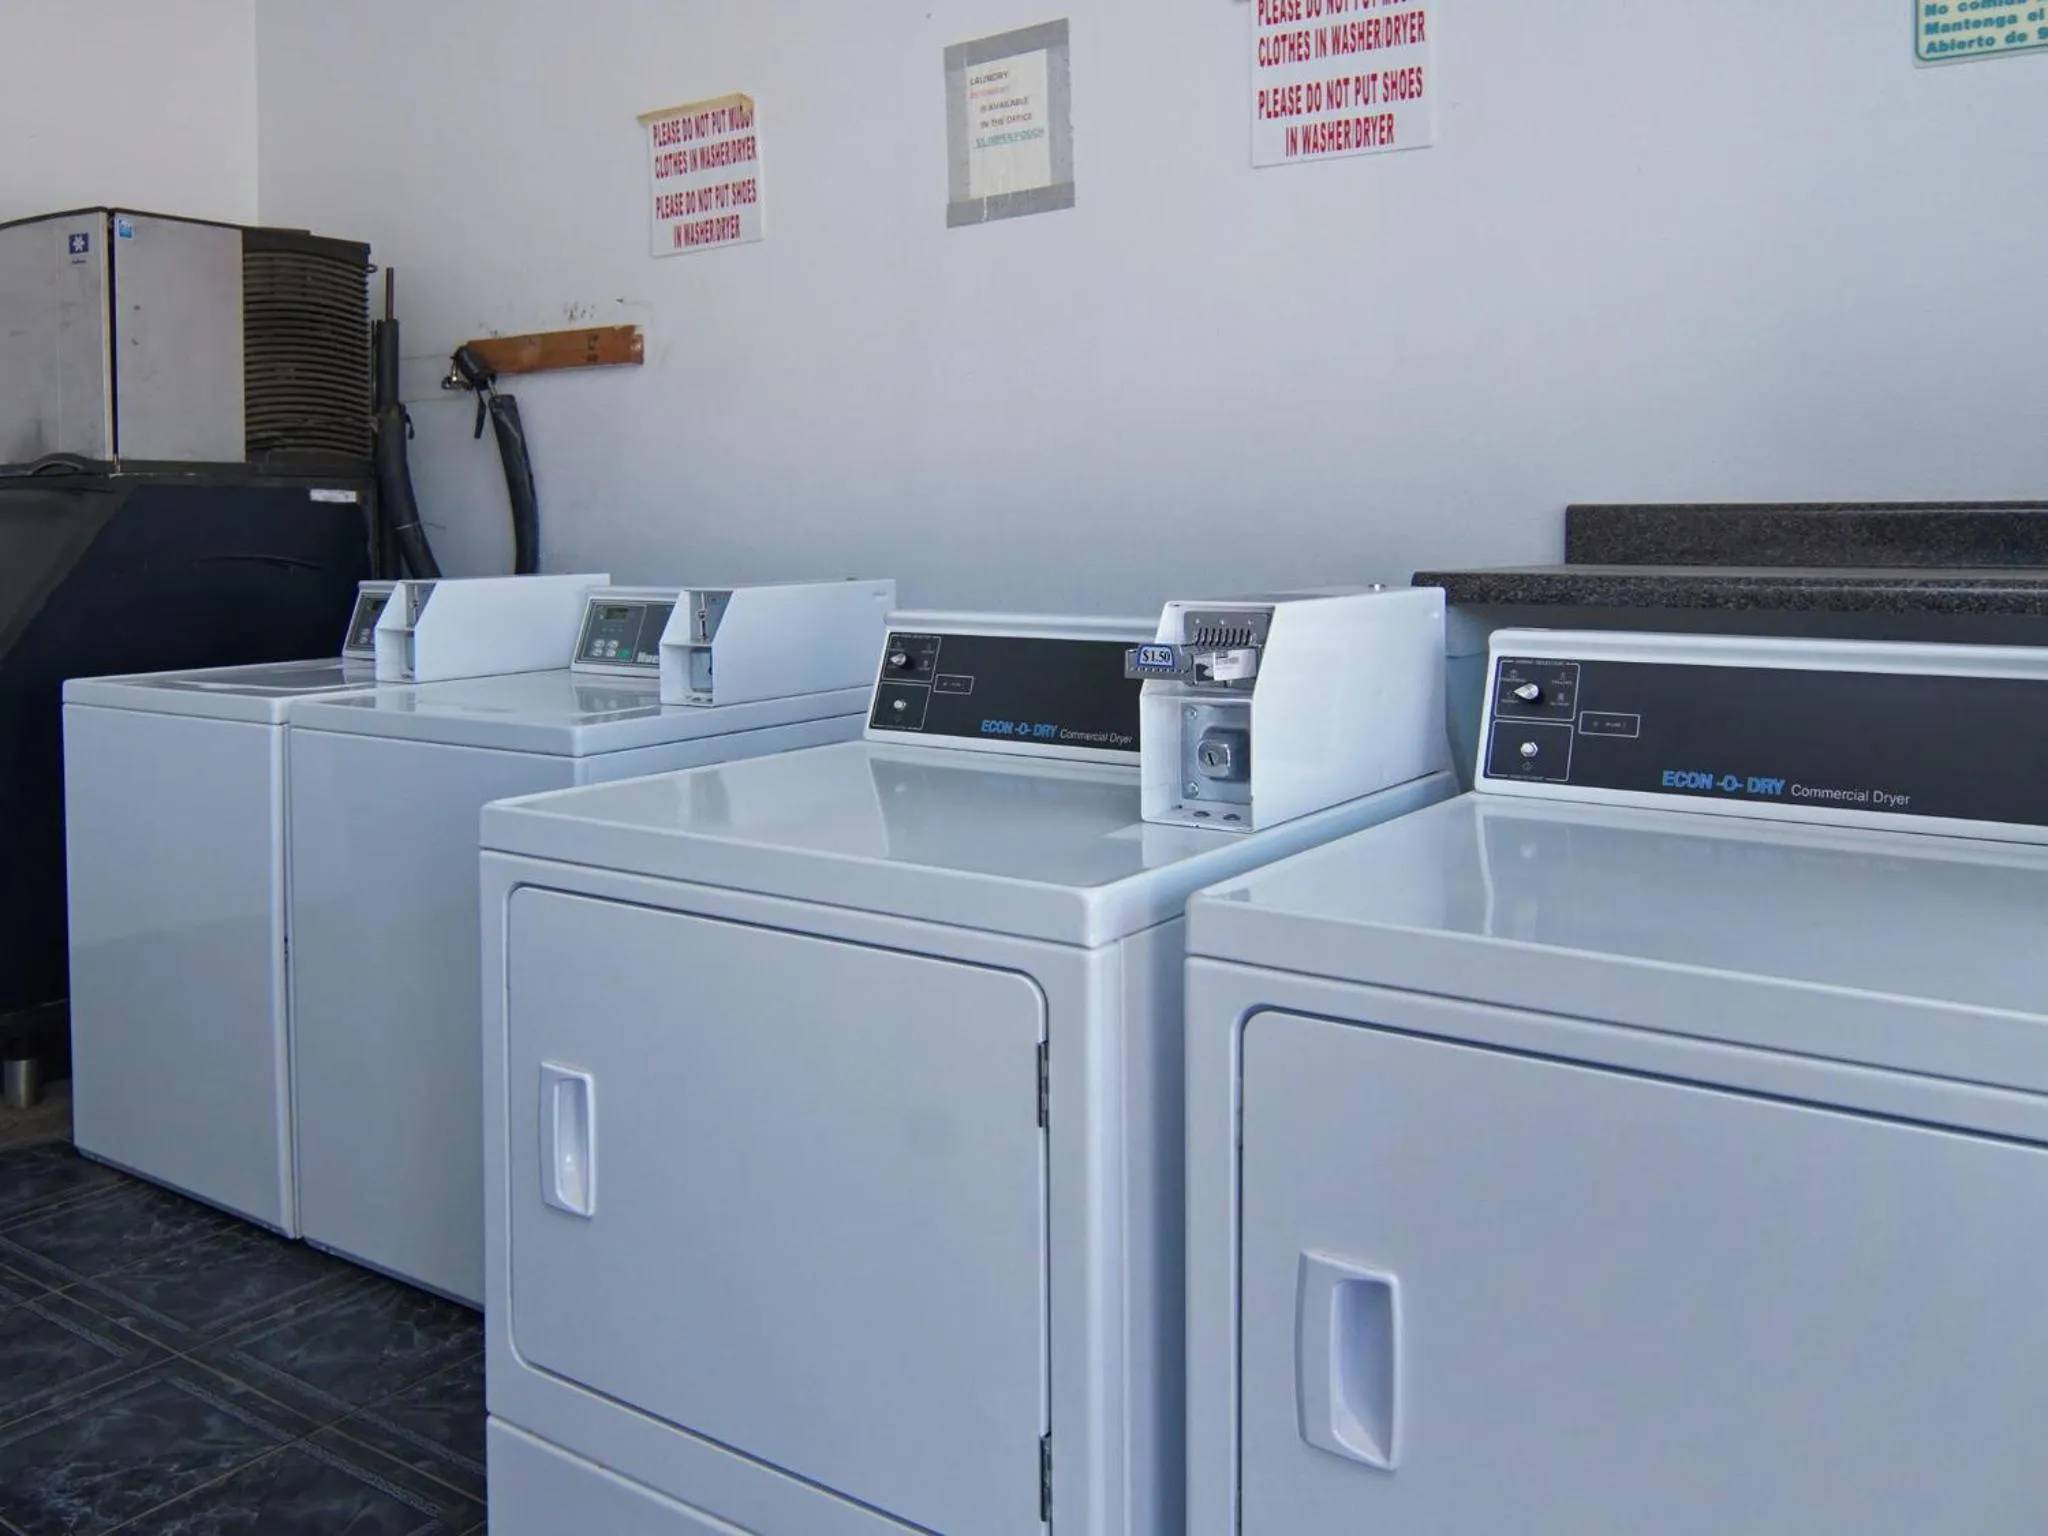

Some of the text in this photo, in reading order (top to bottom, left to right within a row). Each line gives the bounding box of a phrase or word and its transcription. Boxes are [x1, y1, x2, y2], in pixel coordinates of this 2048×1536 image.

[1924, 4, 1949, 16] No
[1925, 14, 2018, 35] Mantenga
[1258, 30, 1311, 67] CLOTHES
[1315, 28, 1328, 59] IN
[1926, 36, 1996, 54] Abierto
[2005, 30, 2028, 44] de
[1258, 66, 1423, 120] PLEASE DO NOT PUT SHOES
[653, 119, 681, 147] PLEASE
[682, 117, 693, 142] DO
[695, 113, 710, 139] NOT
[712, 109, 726, 135] PUT
[1286, 126, 1298, 158] IN
[655, 150, 688, 179] CLOTHES
[689, 147, 698, 172] IN
[656, 178, 756, 219] PLEASE DO NOT PUT SHOES
[673, 224, 682, 248] IN
[1143, 648, 1171, 663] $1.50
[1060, 728, 1108, 743] Commercial
[1109, 732, 1133, 746] Dryer
[1791, 784, 1869, 803] Commercial
[1873, 790, 1911, 807] Dryer
